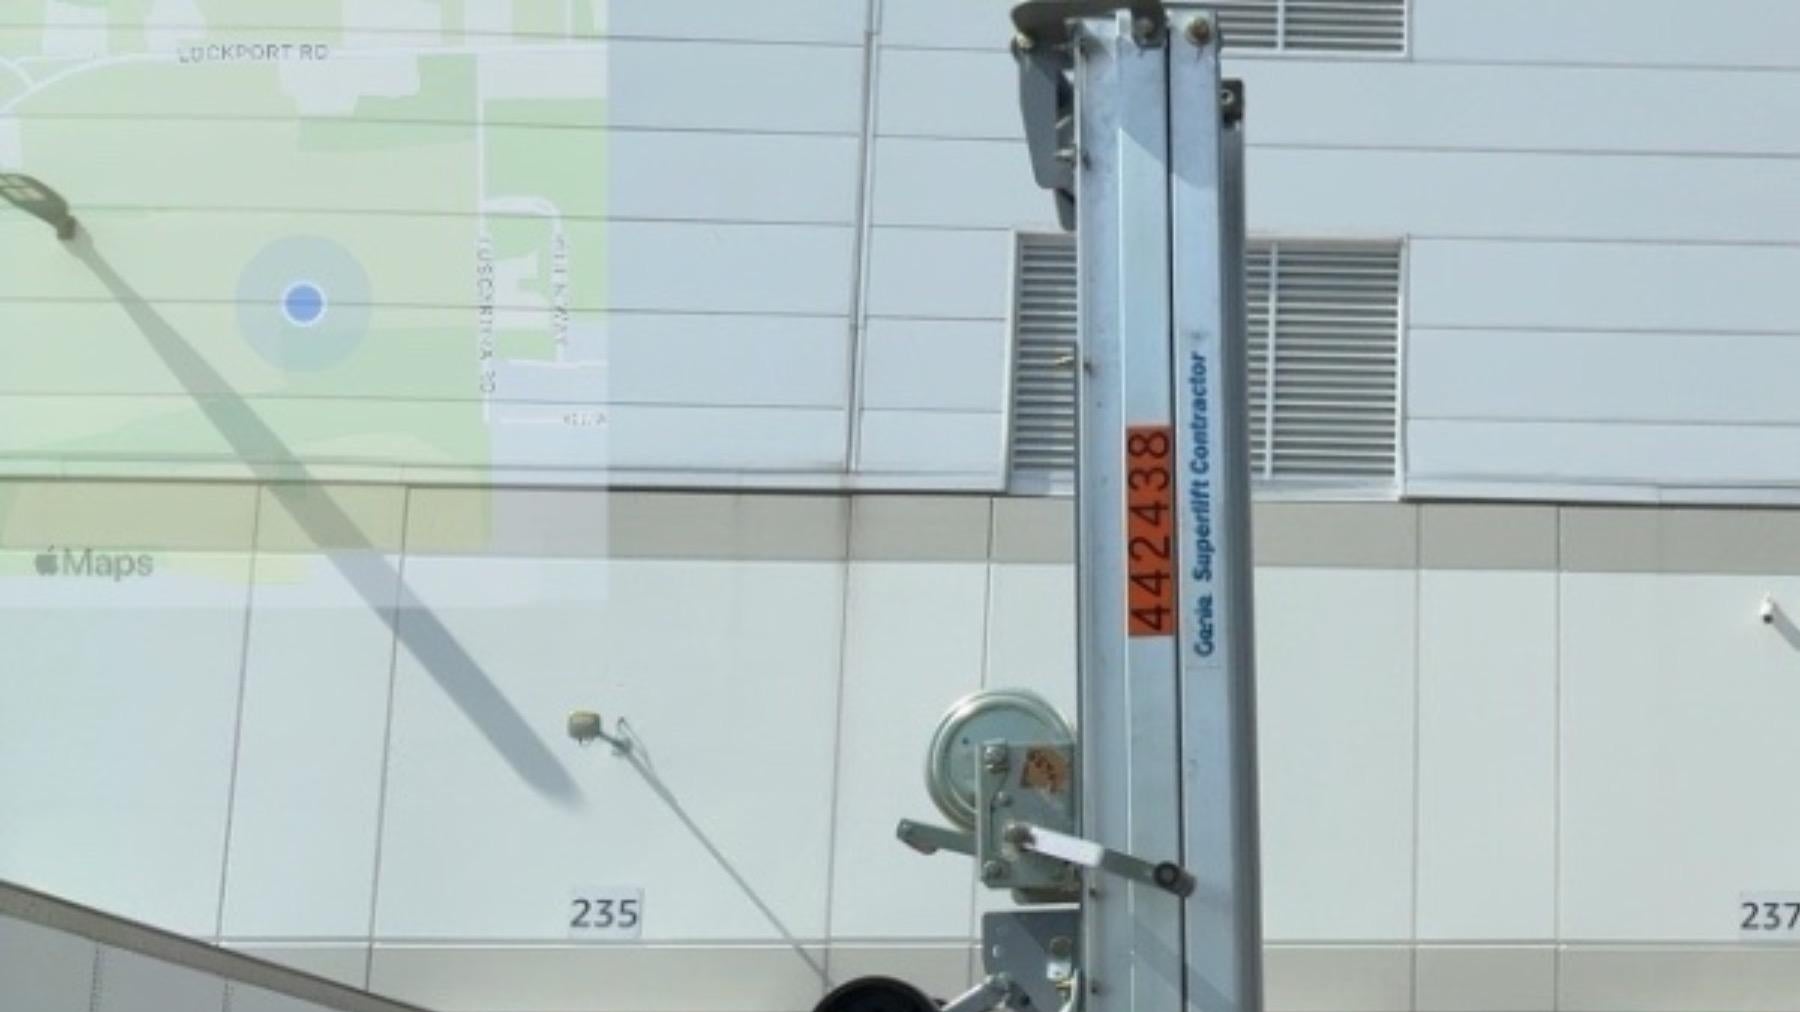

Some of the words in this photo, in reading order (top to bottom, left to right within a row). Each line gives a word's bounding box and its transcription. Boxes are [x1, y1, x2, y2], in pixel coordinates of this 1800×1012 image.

[1188, 352, 1210, 475] Contractor
[1127, 431, 1171, 631] 442438
[1189, 479, 1215, 582] Superlift
[1194, 593, 1214, 657] Genie
[569, 898, 638, 928] 235
